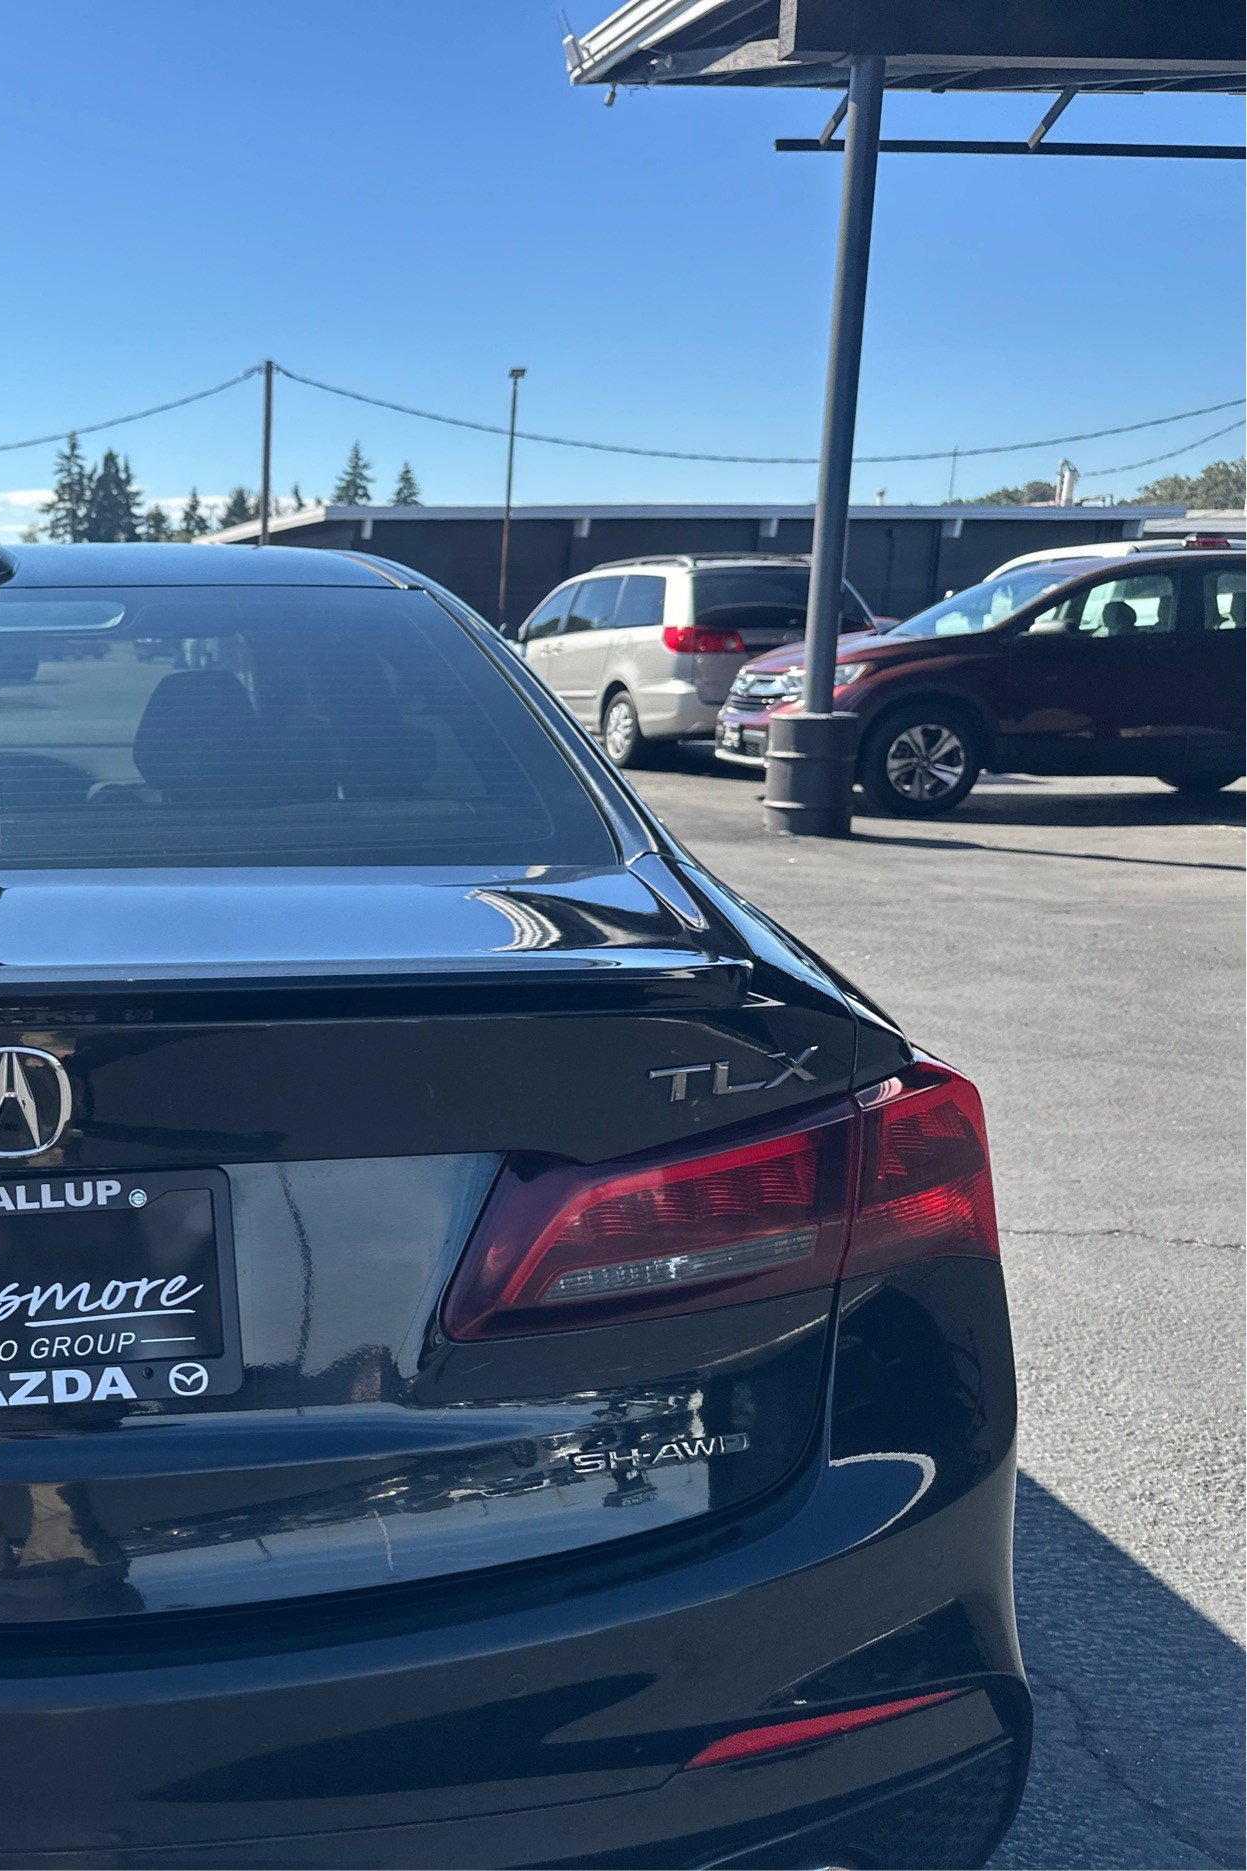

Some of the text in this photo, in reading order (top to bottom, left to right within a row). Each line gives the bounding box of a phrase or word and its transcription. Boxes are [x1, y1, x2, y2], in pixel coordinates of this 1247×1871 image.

[649, 1045, 819, 1102] TLX
[30, 1332, 137, 1358] GROUP
[572, 1432, 750, 1474] SH-AWD
